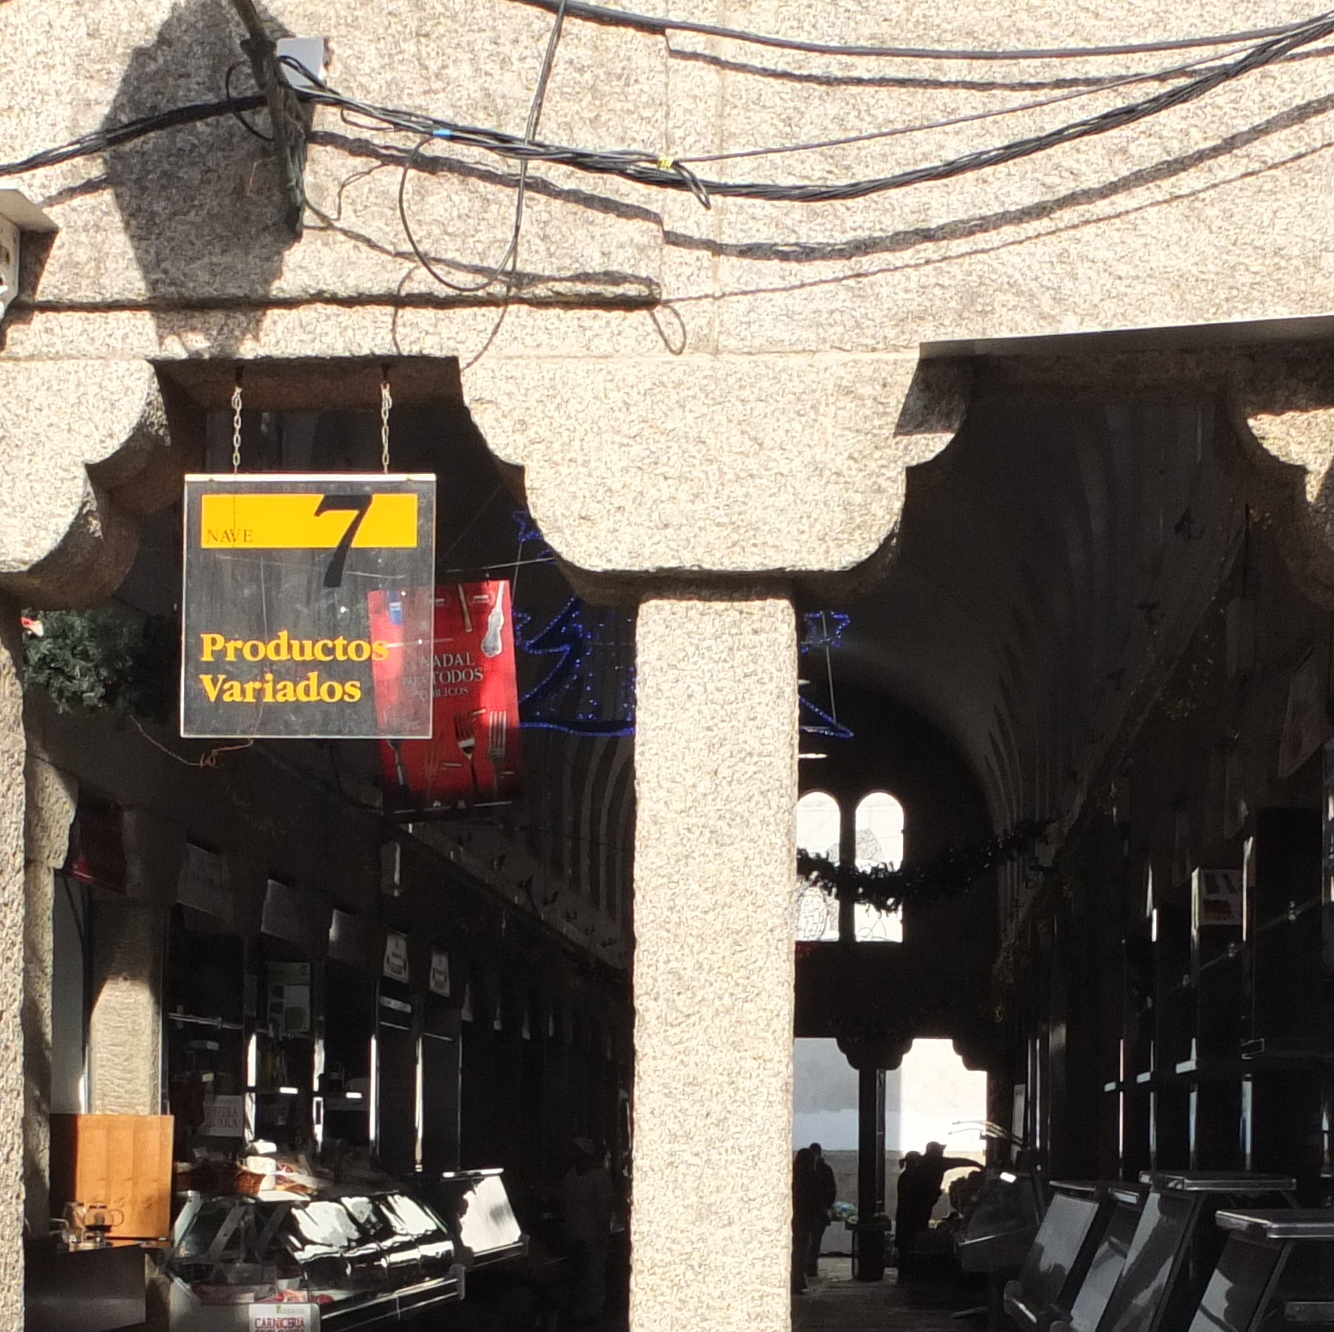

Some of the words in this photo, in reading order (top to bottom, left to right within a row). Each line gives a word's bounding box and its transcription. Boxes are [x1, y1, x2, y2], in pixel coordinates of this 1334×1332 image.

[206, 528, 254, 544] NAVE
[313, 494, 375, 588] 7
[199, 629, 390, 662] Productos
[198, 671, 363, 703] Variados
